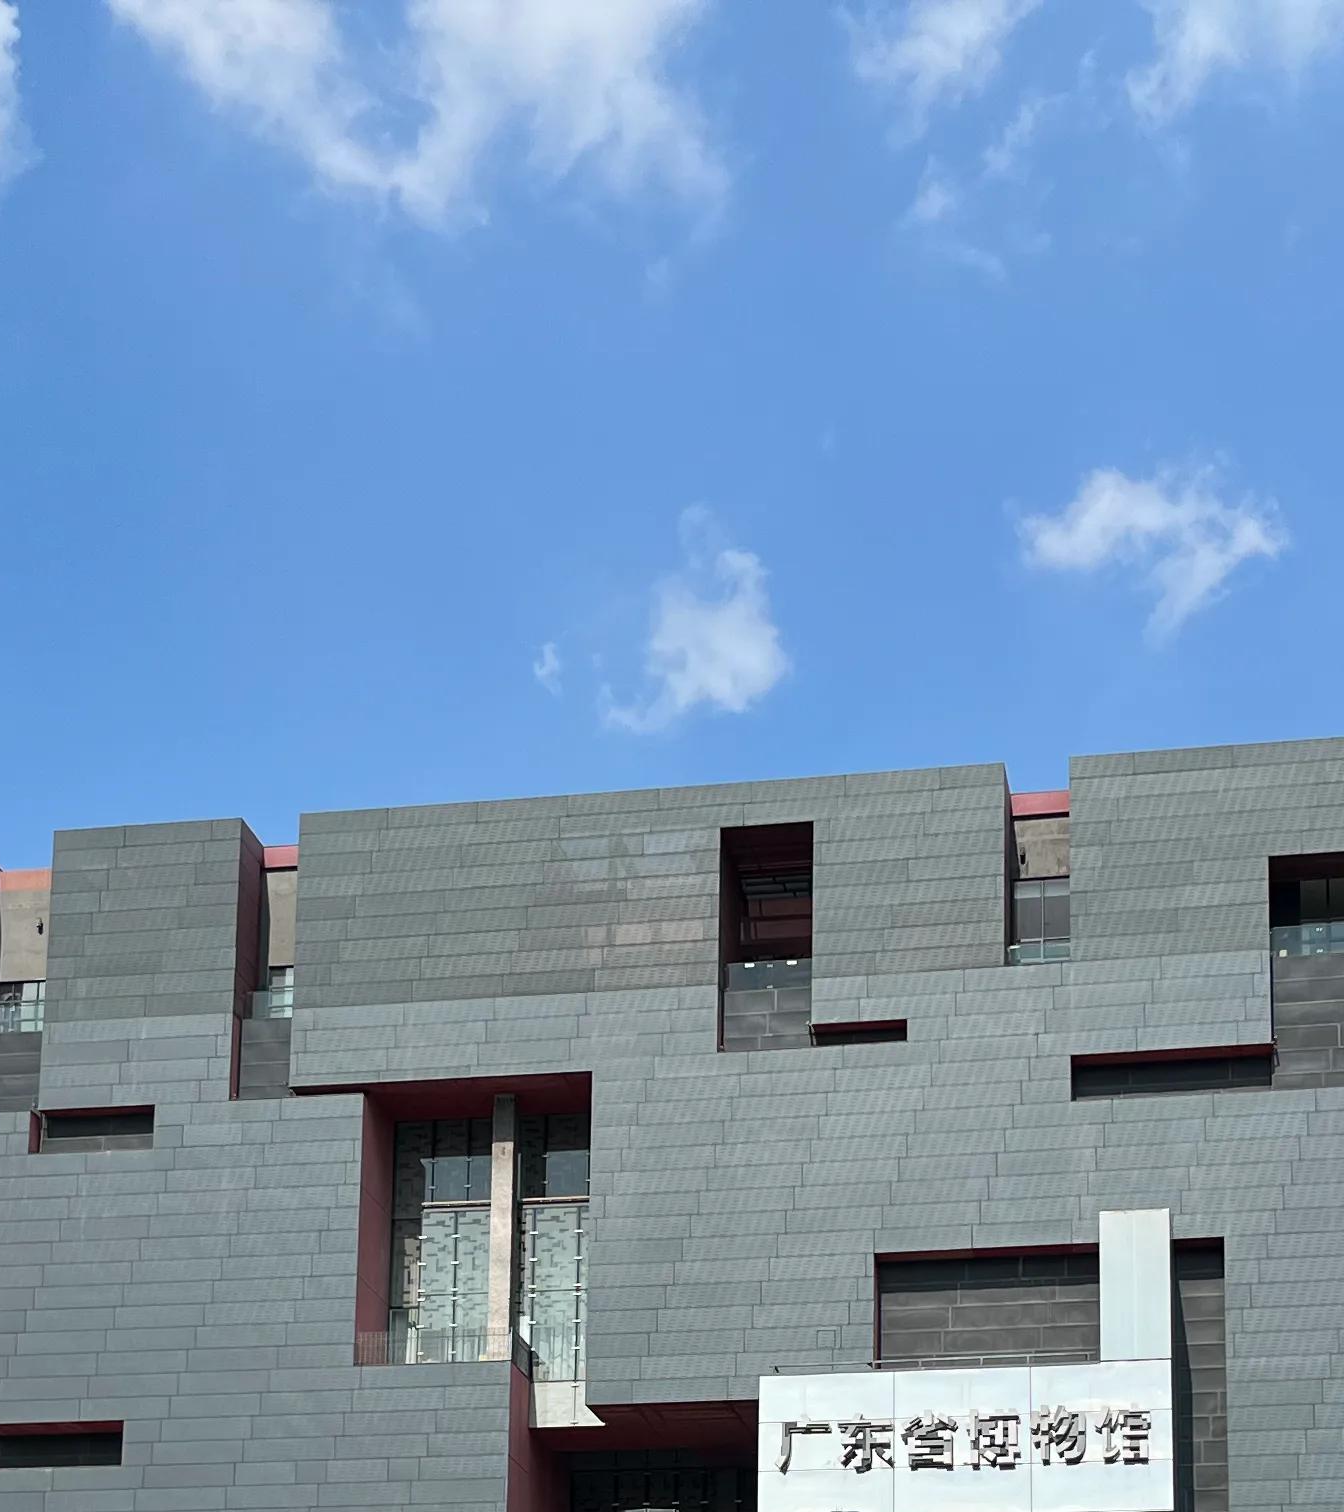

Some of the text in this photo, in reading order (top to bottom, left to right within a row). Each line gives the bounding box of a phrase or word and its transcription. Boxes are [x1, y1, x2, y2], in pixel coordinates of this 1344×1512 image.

[776, 1404, 1152, 1474] 广东省博物馆
